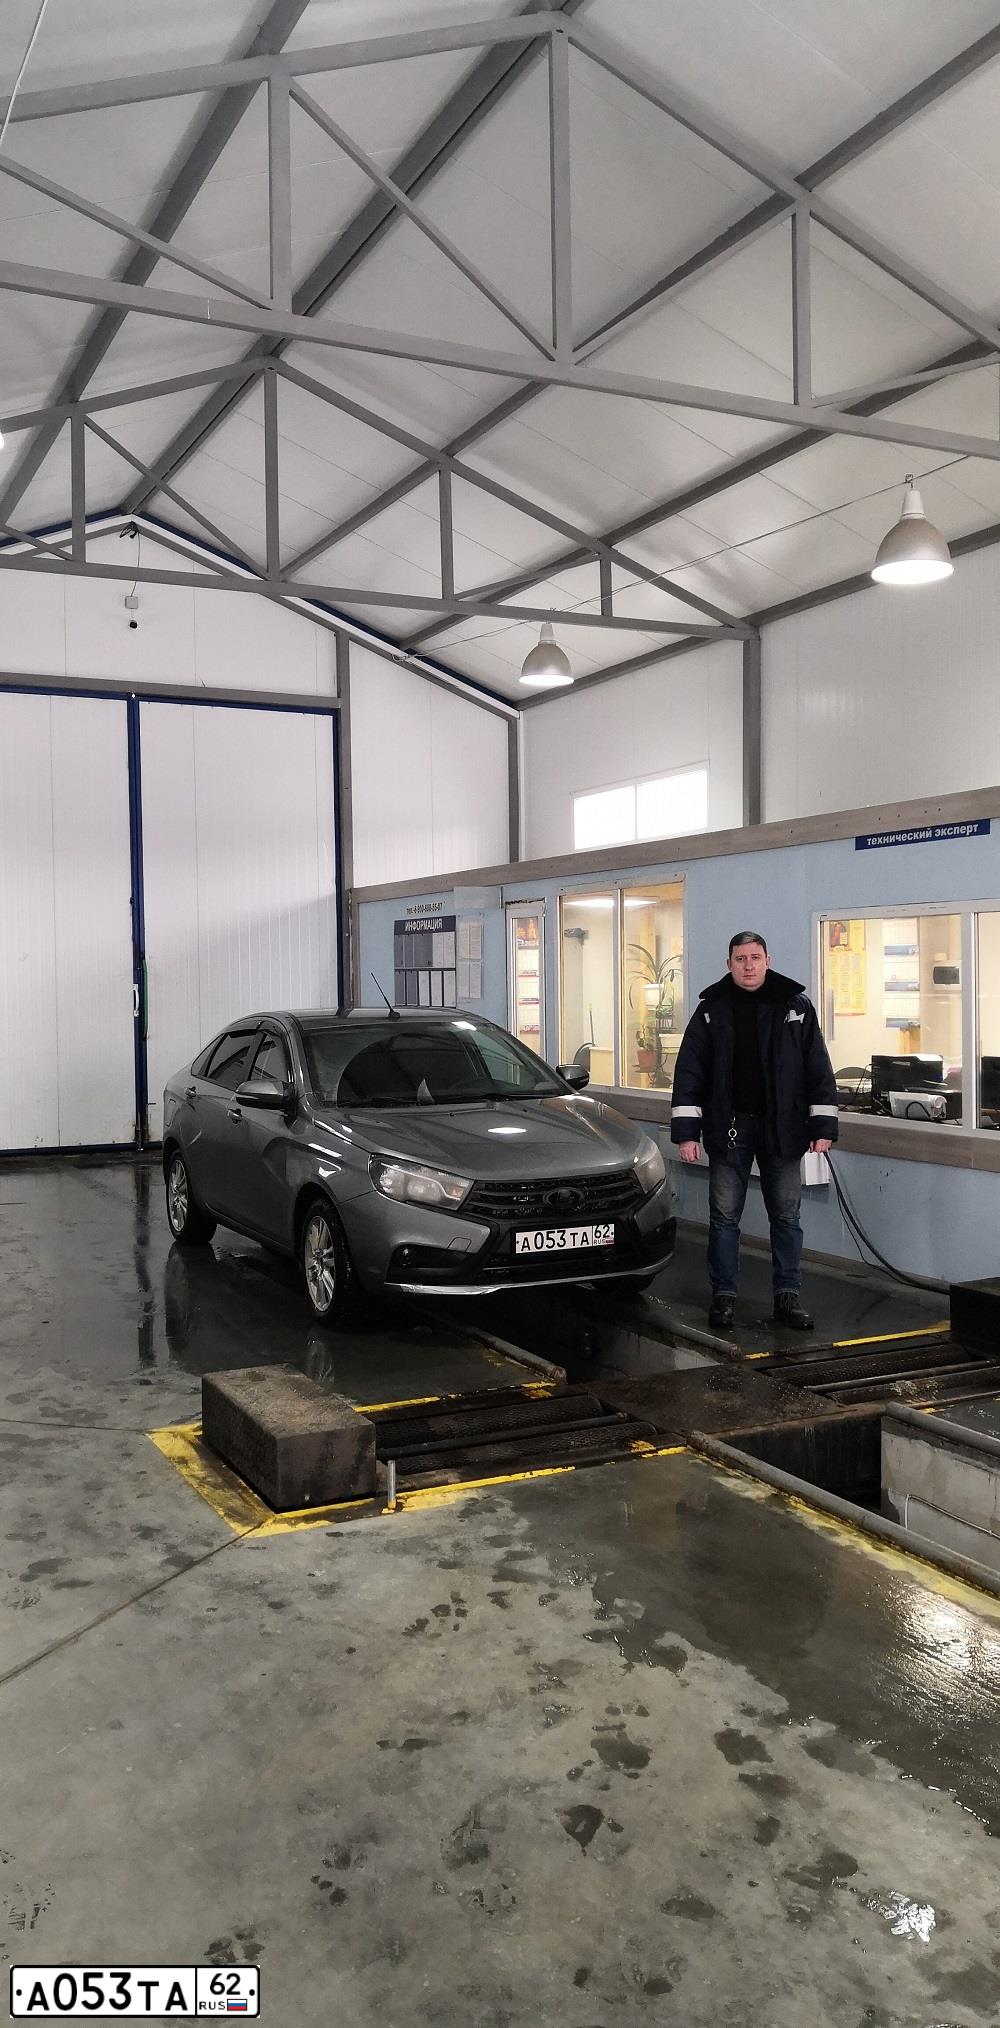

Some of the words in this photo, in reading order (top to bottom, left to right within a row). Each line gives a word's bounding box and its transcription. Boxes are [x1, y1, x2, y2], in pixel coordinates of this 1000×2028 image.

[867, 828, 932, 846] технический
[935, 823, 979, 837] эксперт
[404, 918, 443, 932] ИНФОРМАЦИЯ
[594, 1224, 610, 1239] 62
